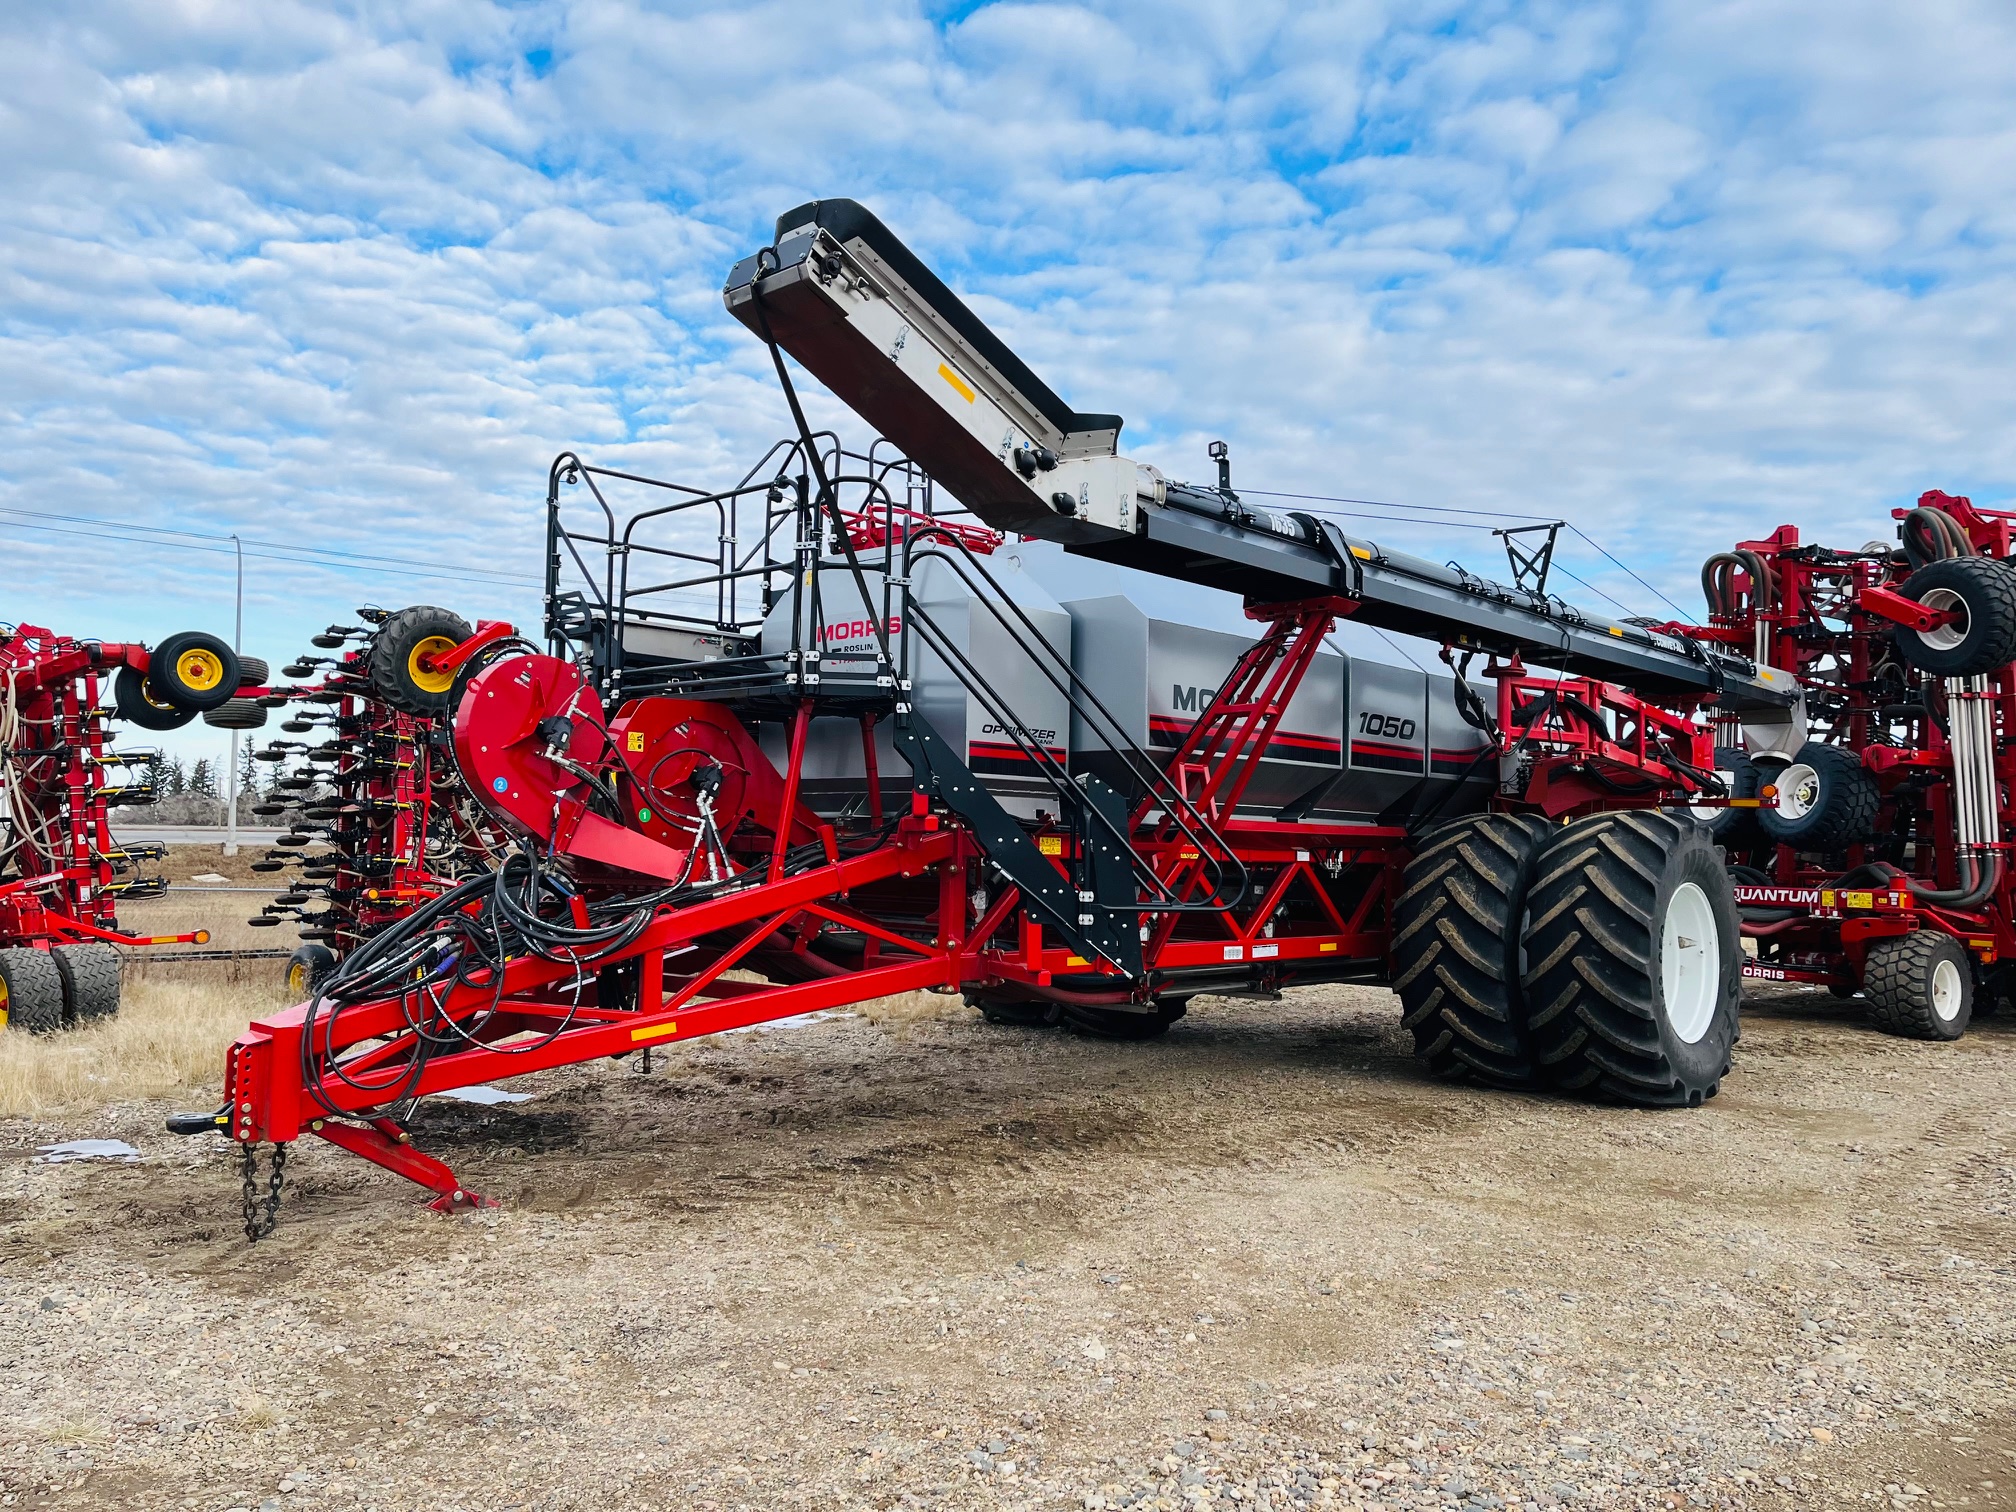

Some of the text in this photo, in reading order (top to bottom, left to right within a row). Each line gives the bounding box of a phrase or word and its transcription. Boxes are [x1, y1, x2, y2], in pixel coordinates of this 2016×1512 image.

[1269, 514, 1296, 537] 1635
[844, 643, 873, 652] ROSLIN
[1359, 711, 1416, 740] 1050
[1733, 888, 1819, 903] QUANTUM
[1743, 966, 1785, 979] ORRIS
